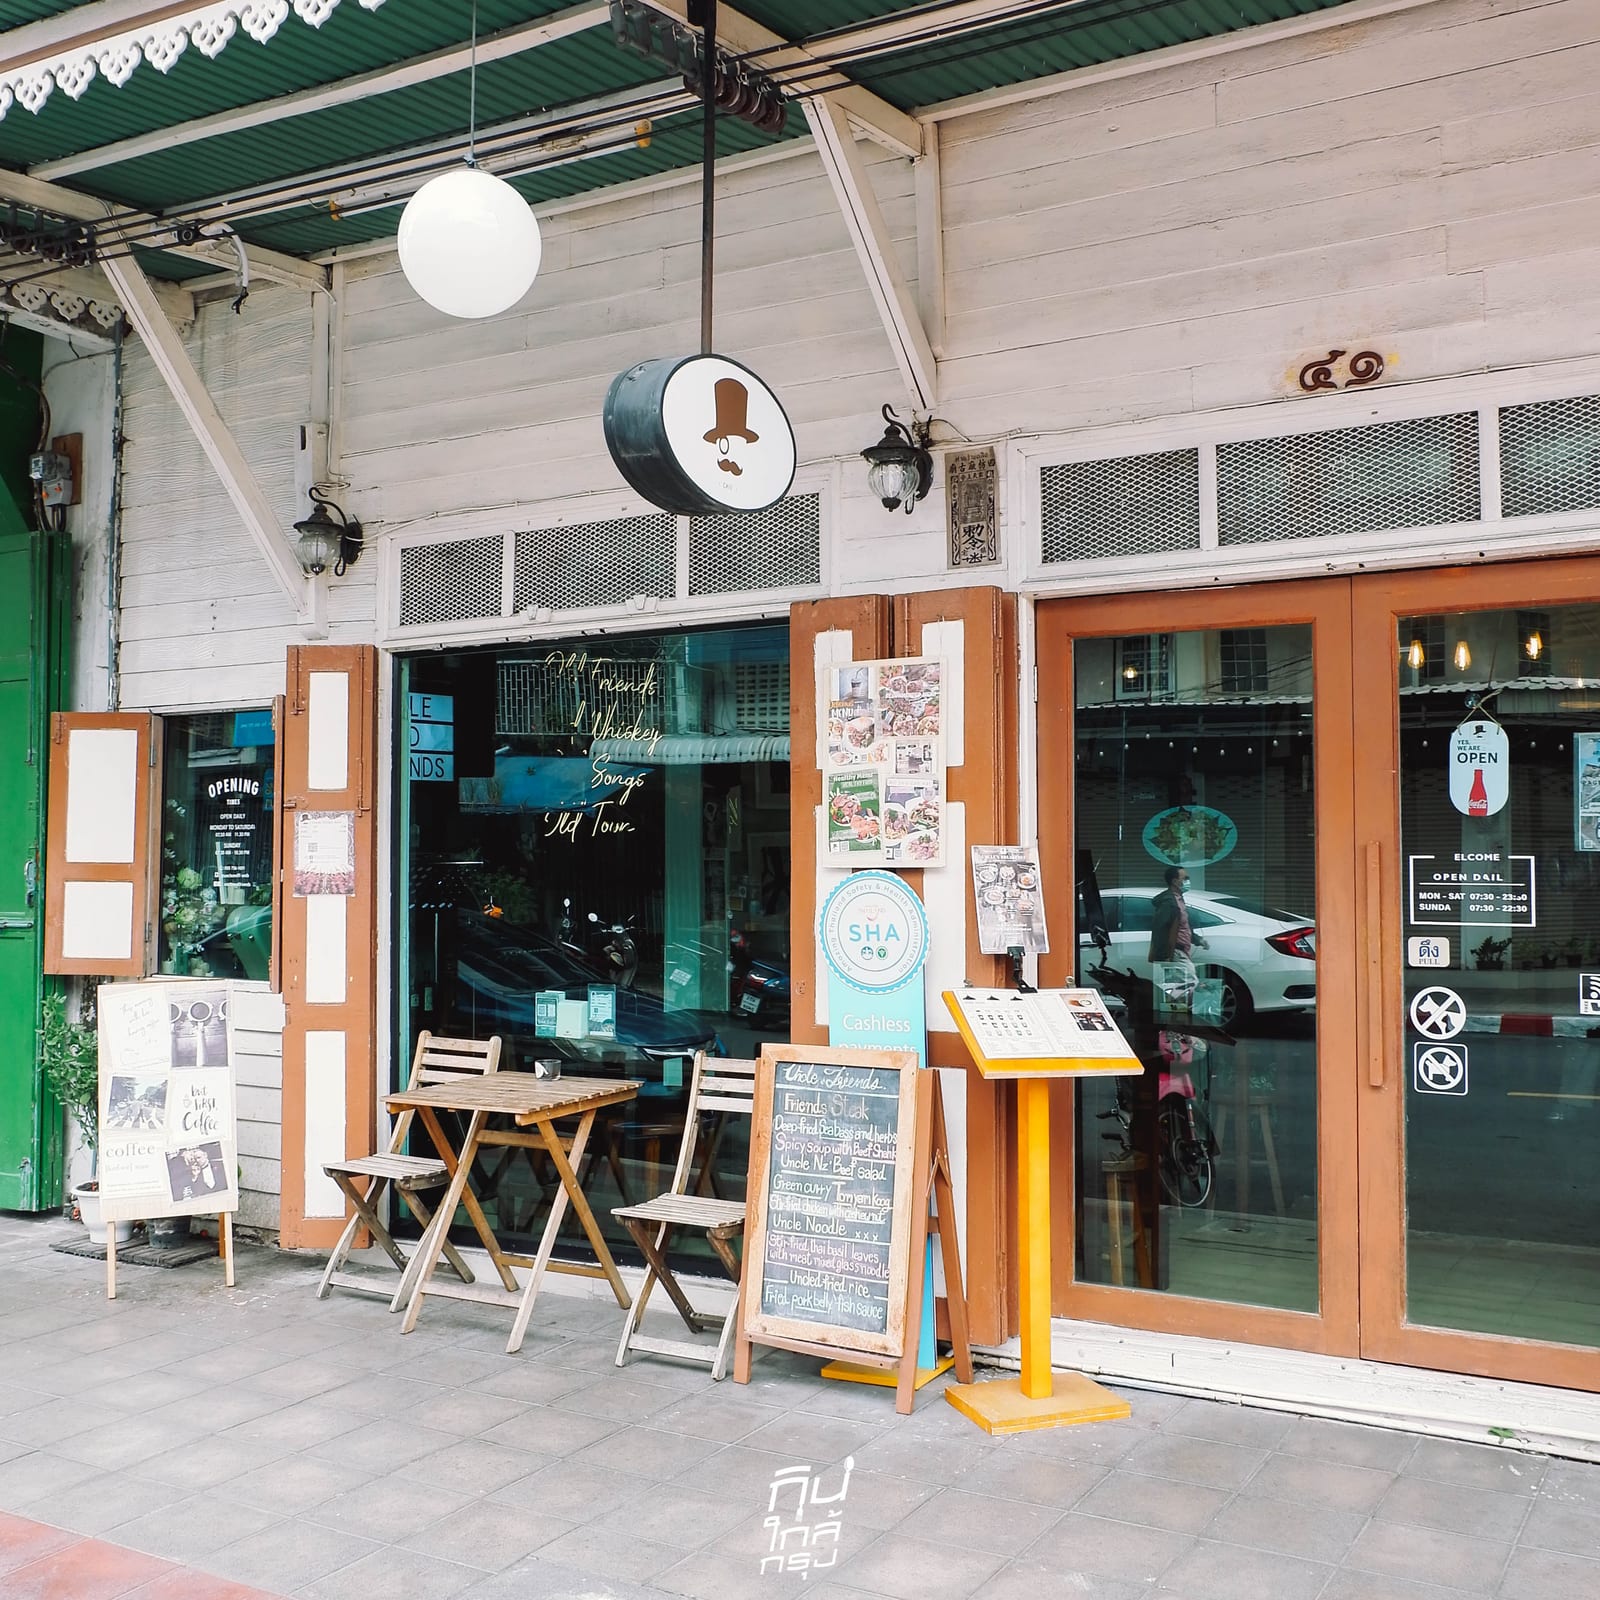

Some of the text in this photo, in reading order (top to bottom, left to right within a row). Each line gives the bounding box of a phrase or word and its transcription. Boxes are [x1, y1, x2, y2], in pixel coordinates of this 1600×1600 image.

[1458, 752, 1498, 764] OPEN
[208, 778, 260, 798] OPENING
[592, 753, 646, 806] Songs
[846, 883, 872, 897] Safety
[884, 886, 909, 907] Health
[849, 924, 900, 942] SHA
[1419, 939, 1440, 958] ดึง
[843, 1014, 911, 1032] Cashless
[784, 1092, 828, 1114] Friends
[106, 1143, 156, 1158] coffee
[774, 1132, 806, 1156] Spicy
[780, 1154, 810, 1170] Uncle
[773, 1174, 802, 1190] Green
[773, 1212, 802, 1230] Uncle
[805, 1216, 847, 1236] Noodle
[765, 1285, 790, 1306] Fried
[848, 1284, 870, 1298] rice
